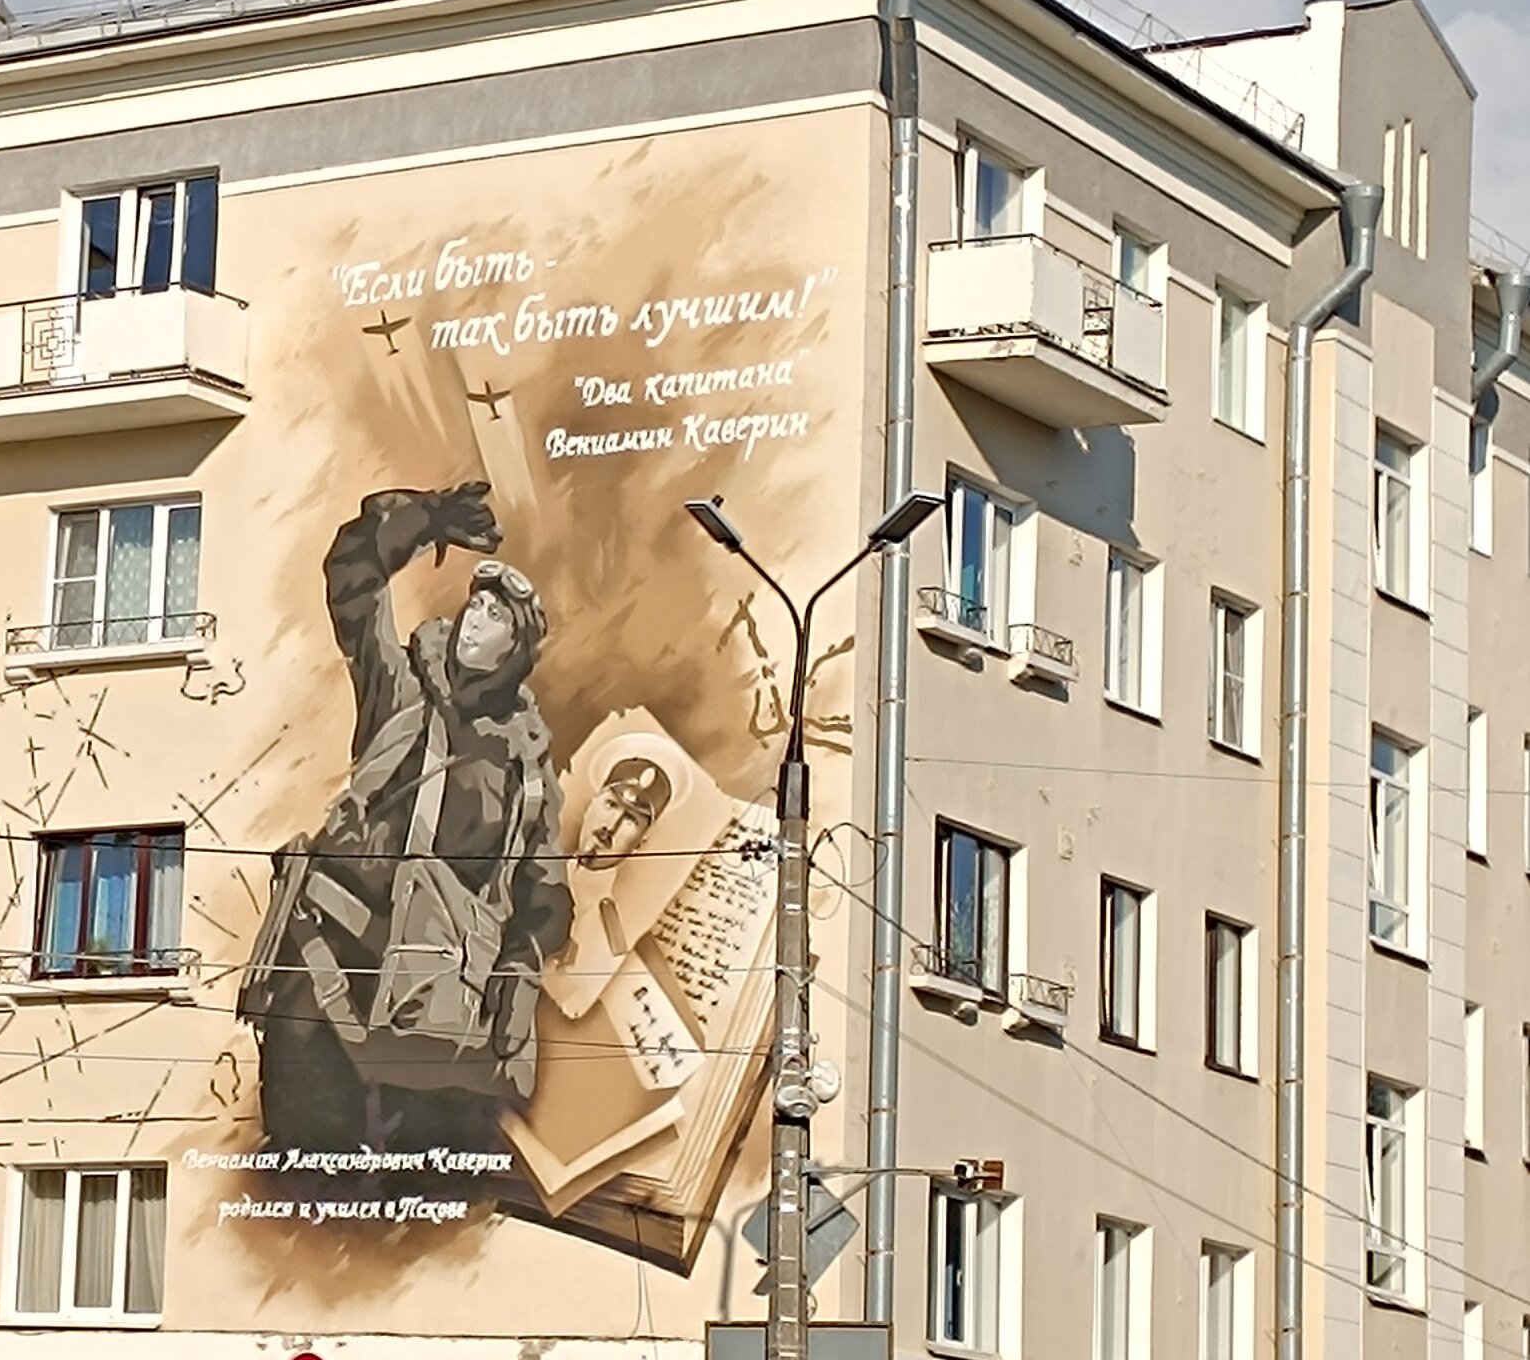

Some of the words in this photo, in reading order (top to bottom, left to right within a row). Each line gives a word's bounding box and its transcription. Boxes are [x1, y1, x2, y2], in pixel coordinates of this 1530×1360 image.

[434, 236, 535, 292] быть
[430, 311, 511, 356] так
[513, 293, 619, 343] быть
[545, 425, 673, 459] Вениамин
[682, 411, 810, 462] Каверин
[427, 1146, 514, 1177] Каверин
[217, 1191, 295, 1227] родился
[298, 1202, 311, 1219] и
[311, 1201, 381, 1226] учился
[384, 1201, 396, 1219] в
[395, 1196, 469, 1225] Пскове
